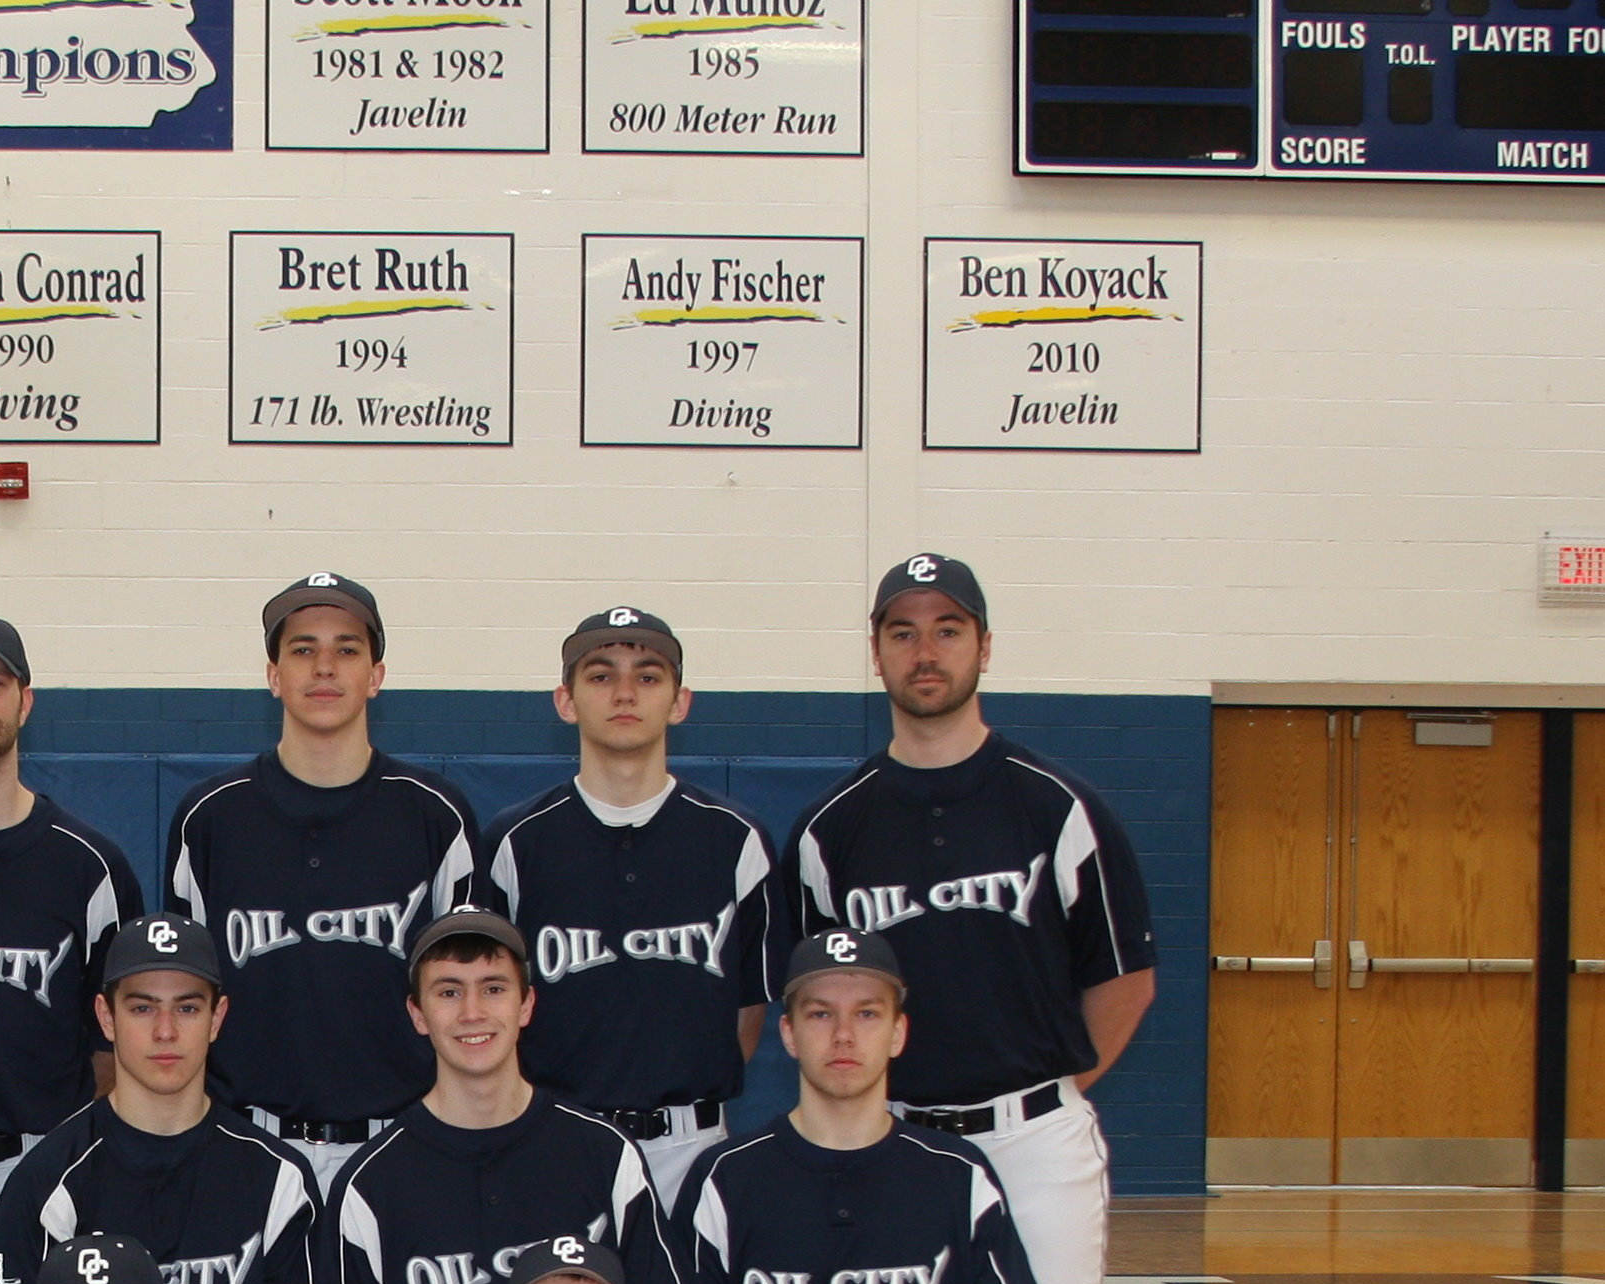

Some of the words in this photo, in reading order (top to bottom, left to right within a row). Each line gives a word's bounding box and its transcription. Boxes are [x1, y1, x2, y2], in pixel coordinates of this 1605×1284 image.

[1281, 22, 1366, 49] FOULS
[1451, 25, 1551, 53] PLAYER
[1568, 27, 1605, 54] FO
[312, 48, 384, 82] 1981
[395, 48, 420, 80] &
[432, 48, 505, 82] 1982
[688, 47, 760, 81] 1985
[1385, 45, 1436, 65] T.O.L.
[350, 97, 468, 137] Javelin
[609, 103, 666, 134] 800
[674, 104, 766, 135] Meter
[773, 105, 838, 136] Run
[1281, 138, 1366, 164] SCORE
[1497, 142, 1589, 169] MATCH
[16, 252, 146, 303] Conrad
[278, 247, 361, 291] Bret
[374, 248, 470, 292] Ruth
[623, 258, 702, 311] Andy
[710, 259, 825, 304] Fischer
[959, 256, 1029, 299] Ben
[1038, 256, 1168, 311] Koyack
[335, 338, 408, 372] 1994
[685, 341, 759, 375] 1997
[1027, 342, 1100, 375] 2010
[249, 395, 300, 428] 171
[309, 395, 343, 428] lb.
[356, 395, 492, 436] Wrestling
[668, 397, 773, 437] Diving
[1001, 394, 1120, 433] Javelin
[907, 557, 937, 583] OC
[1559, 547, 1605, 584] EXIT
[846, 884, 926, 933] OIL
[928, 853, 1045, 926] CITY
[148, 920, 178, 954] OC
[226, 908, 302, 969] OIL
[306, 880, 426, 960] CITY
[536, 926, 618, 984] OIL
[622, 900, 736, 977] CITY
[826, 932, 857, 963] OC
[552, 1235, 585, 1265] OC
